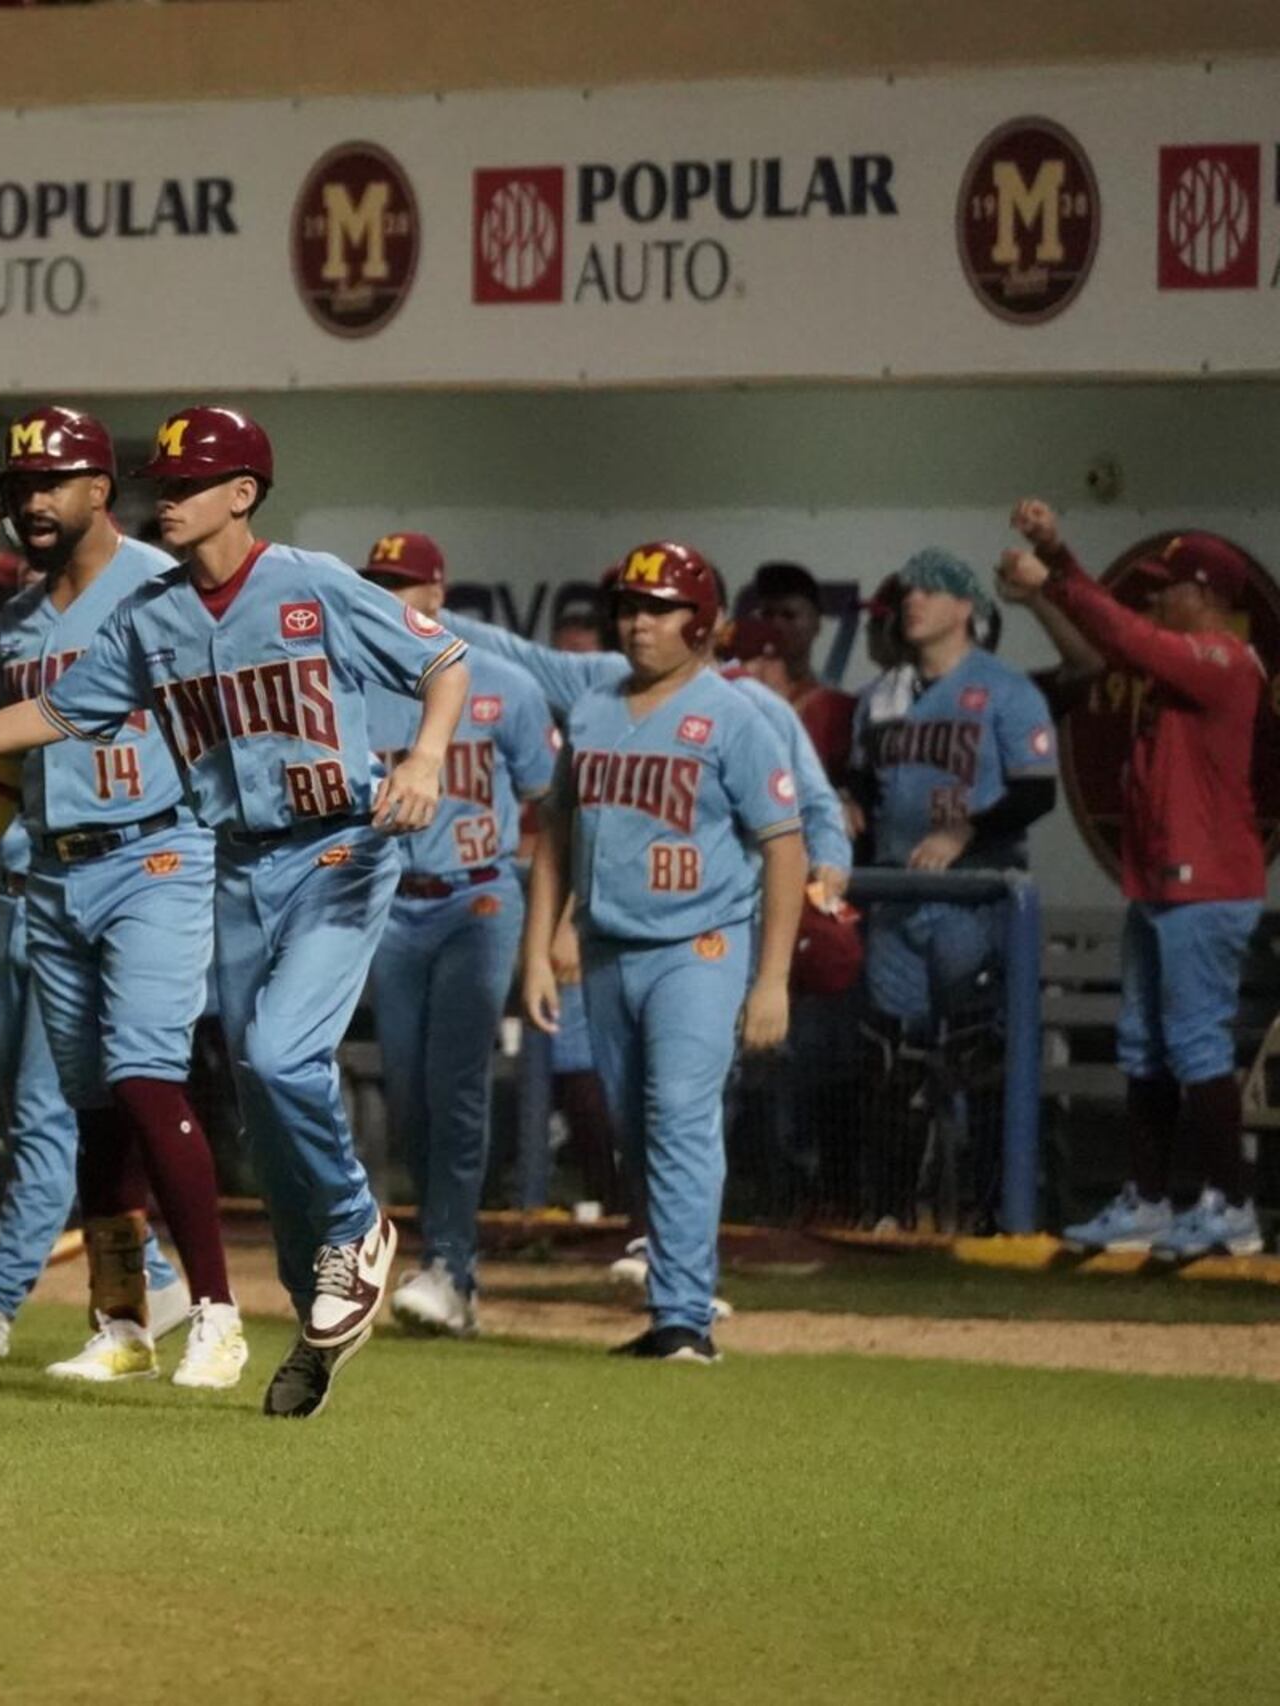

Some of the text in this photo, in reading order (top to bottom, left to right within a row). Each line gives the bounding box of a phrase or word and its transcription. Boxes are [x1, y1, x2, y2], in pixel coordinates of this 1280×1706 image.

[577, 154, 899, 223] POPULAR
[991, 160, 1065, 263] M
[321, 183, 389, 279] M
[574, 239, 731, 304] AUTO
[10, 420, 47, 458] M
[156, 419, 190, 457] M
[375, 537, 405, 560] M
[625, 552, 666, 583] M
[94, 746, 144, 801] 14
[286, 760, 351, 818] BB
[454, 815, 499, 864] 52
[649, 844, 701, 893] BB
